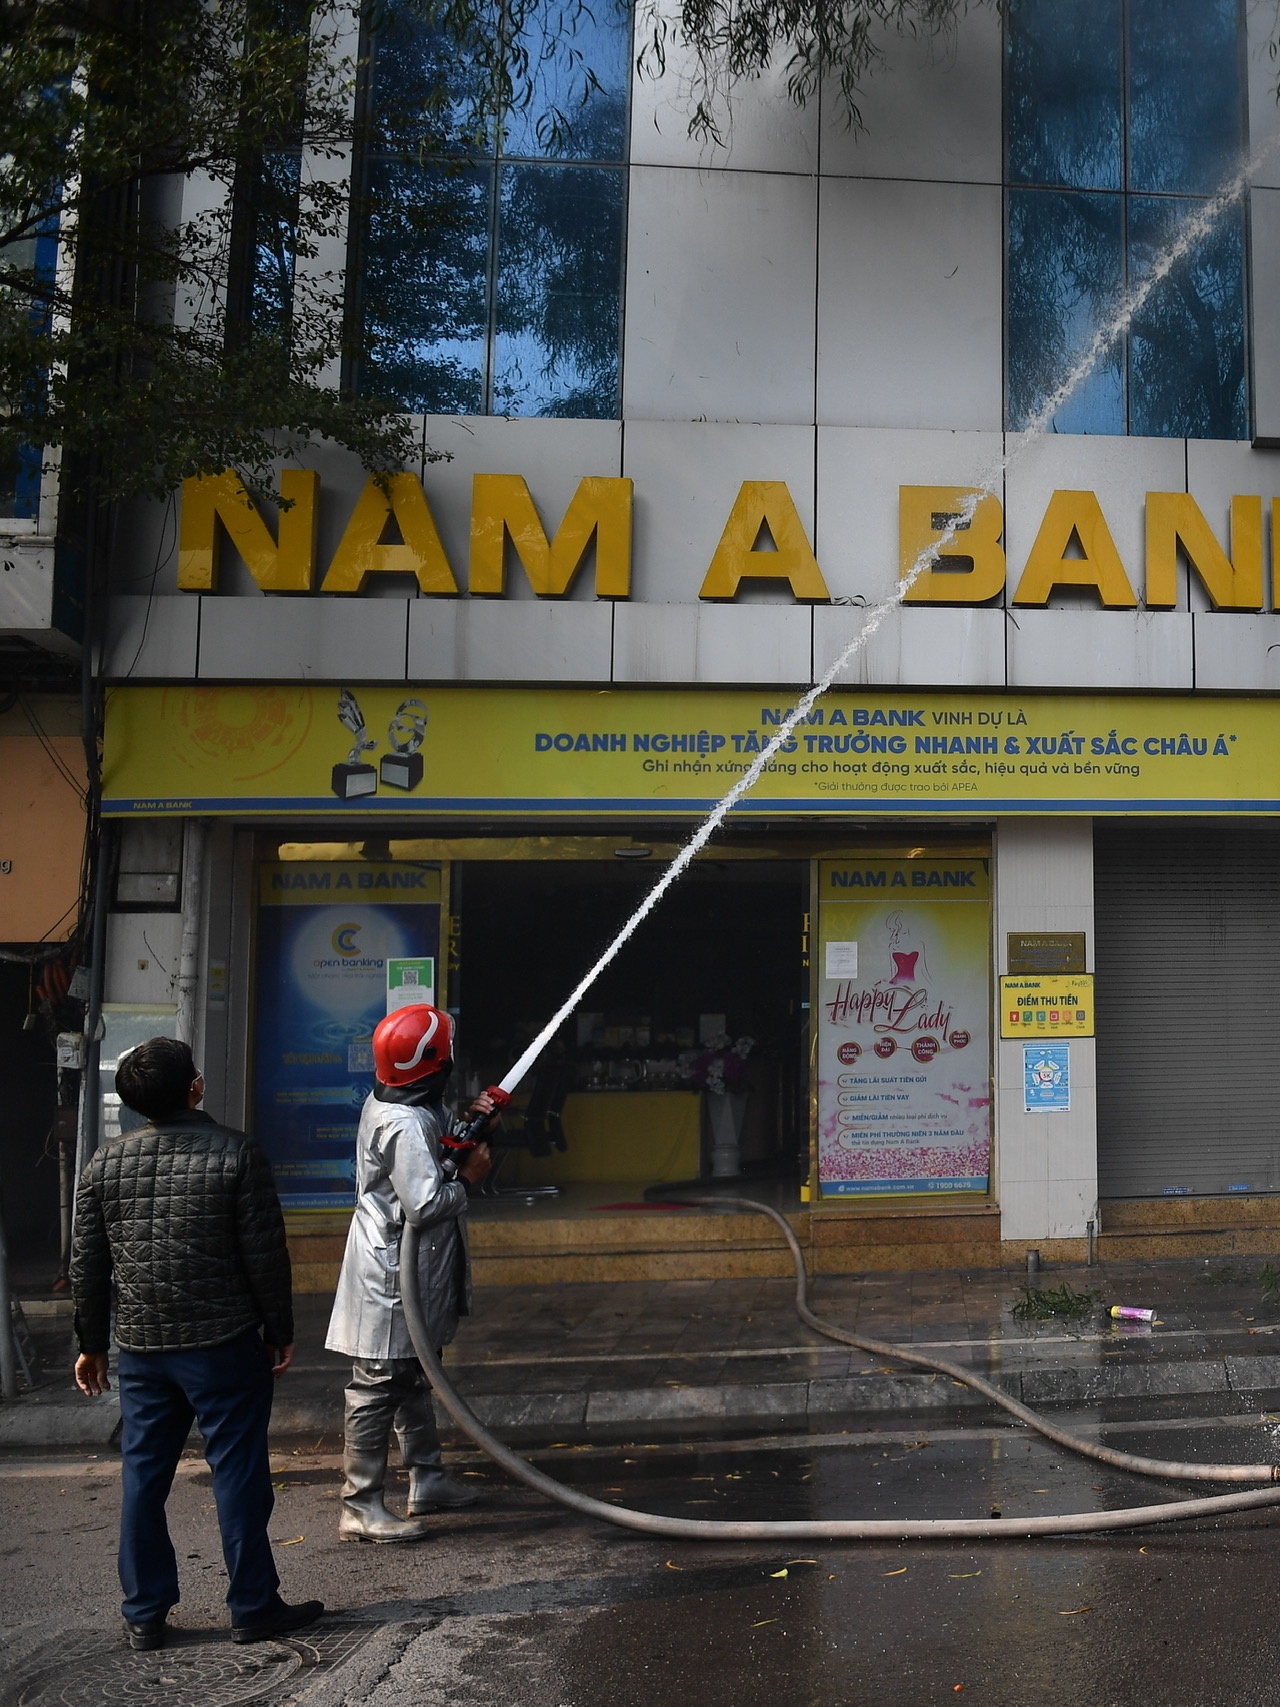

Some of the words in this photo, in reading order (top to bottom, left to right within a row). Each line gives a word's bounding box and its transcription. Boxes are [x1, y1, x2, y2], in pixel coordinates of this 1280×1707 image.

[177, 468, 634, 599] NAM
[699, 479, 832, 604] A
[761, 708, 824, 726] NAM
[829, 709, 847, 725] A
[853, 709, 926, 726] BANK
[932, 711, 972, 725] VINH
[978, 711, 1003, 729] DỰ
[1007, 709, 1028, 726] LÀ
[535, 733, 626, 752] DOANH
[633, 730, 725, 758] NGHIỆP
[803, 730, 907, 754] TRƯỞNG
[915, 736, 997, 754] NHANH
[1004, 736, 1020, 755] &
[1025, 730, 1085, 755] XUẤT
[1091, 730, 1137, 755] SẮC
[1143, 733, 1208, 755] CHÂU
[643, 759, 668, 773] Ghi
[673, 759, 712, 775] nhận
[716, 759, 752, 775] xứng
[801, 761, 829, 774] cho
[833, 761, 867, 776] hoạt
[872, 761, 910, 776] động
[914, 760, 948, 774] xuất
[952, 760, 980, 776] sắc,
[985, 763, 1015, 777] hiệu
[1020, 762, 1047, 777] quả
[1052, 763, 1069, 774] và
[1074, 761, 1101, 774] bền
[1105, 763, 1140, 777] vững
[841, 782, 878, 793] thưởng
[880, 782, 907, 793] được
[910, 783, 930, 791] trao
[933, 782, 949, 791] bởi
[951, 783, 978, 791] APEA
[272, 872, 331, 889] NAM
[336, 872, 352, 888] A
[358, 871, 426, 888] BANK
[831, 871, 886, 887] NAM
[890, 871, 906, 887] A
[912, 871, 976, 887] BANK
[313, 959, 340, 968] open
[342, 958, 383, 968] banking
[1040, 995, 1057, 1006] THU
[826, 980, 897, 1024] Happy
[874, 989, 951, 1042] Lady
